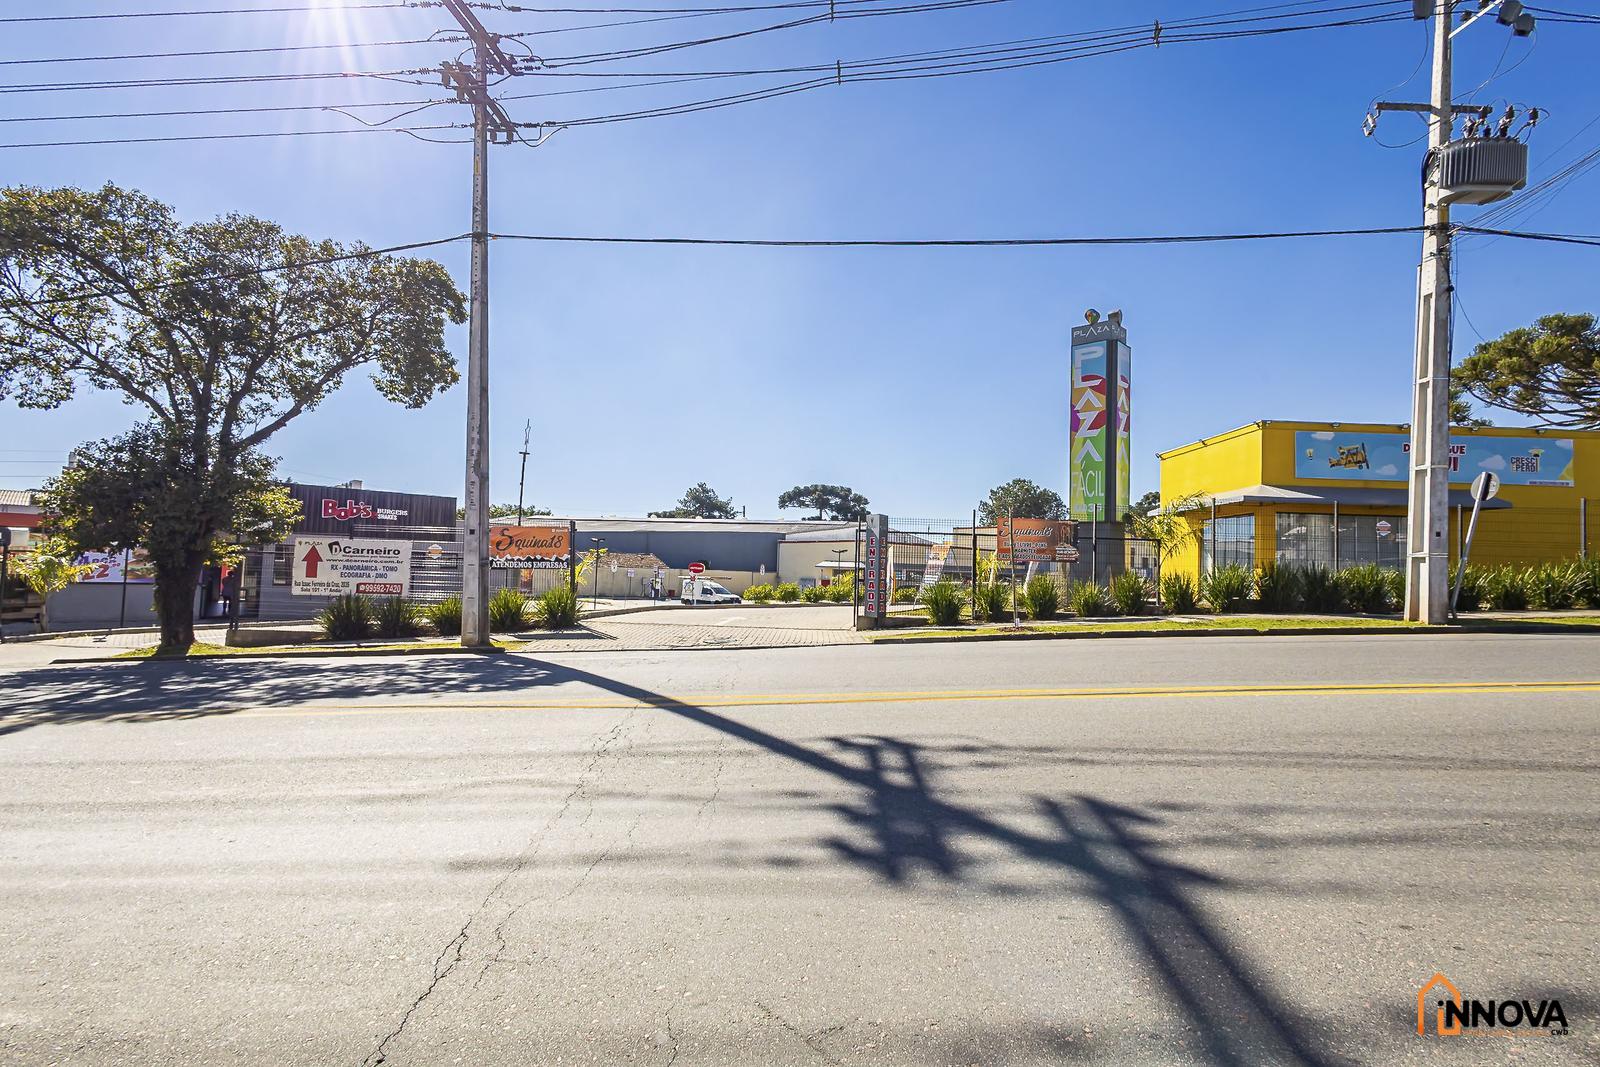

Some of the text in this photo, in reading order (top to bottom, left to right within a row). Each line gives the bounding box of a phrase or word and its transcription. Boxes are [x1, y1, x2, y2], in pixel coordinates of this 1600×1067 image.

[1073, 325, 1110, 338] PLAZA
[322, 499, 372, 520] Bob's
[533, 561, 568, 569] EMPRESAS
[867, 536, 876, 612] ENTRADA
